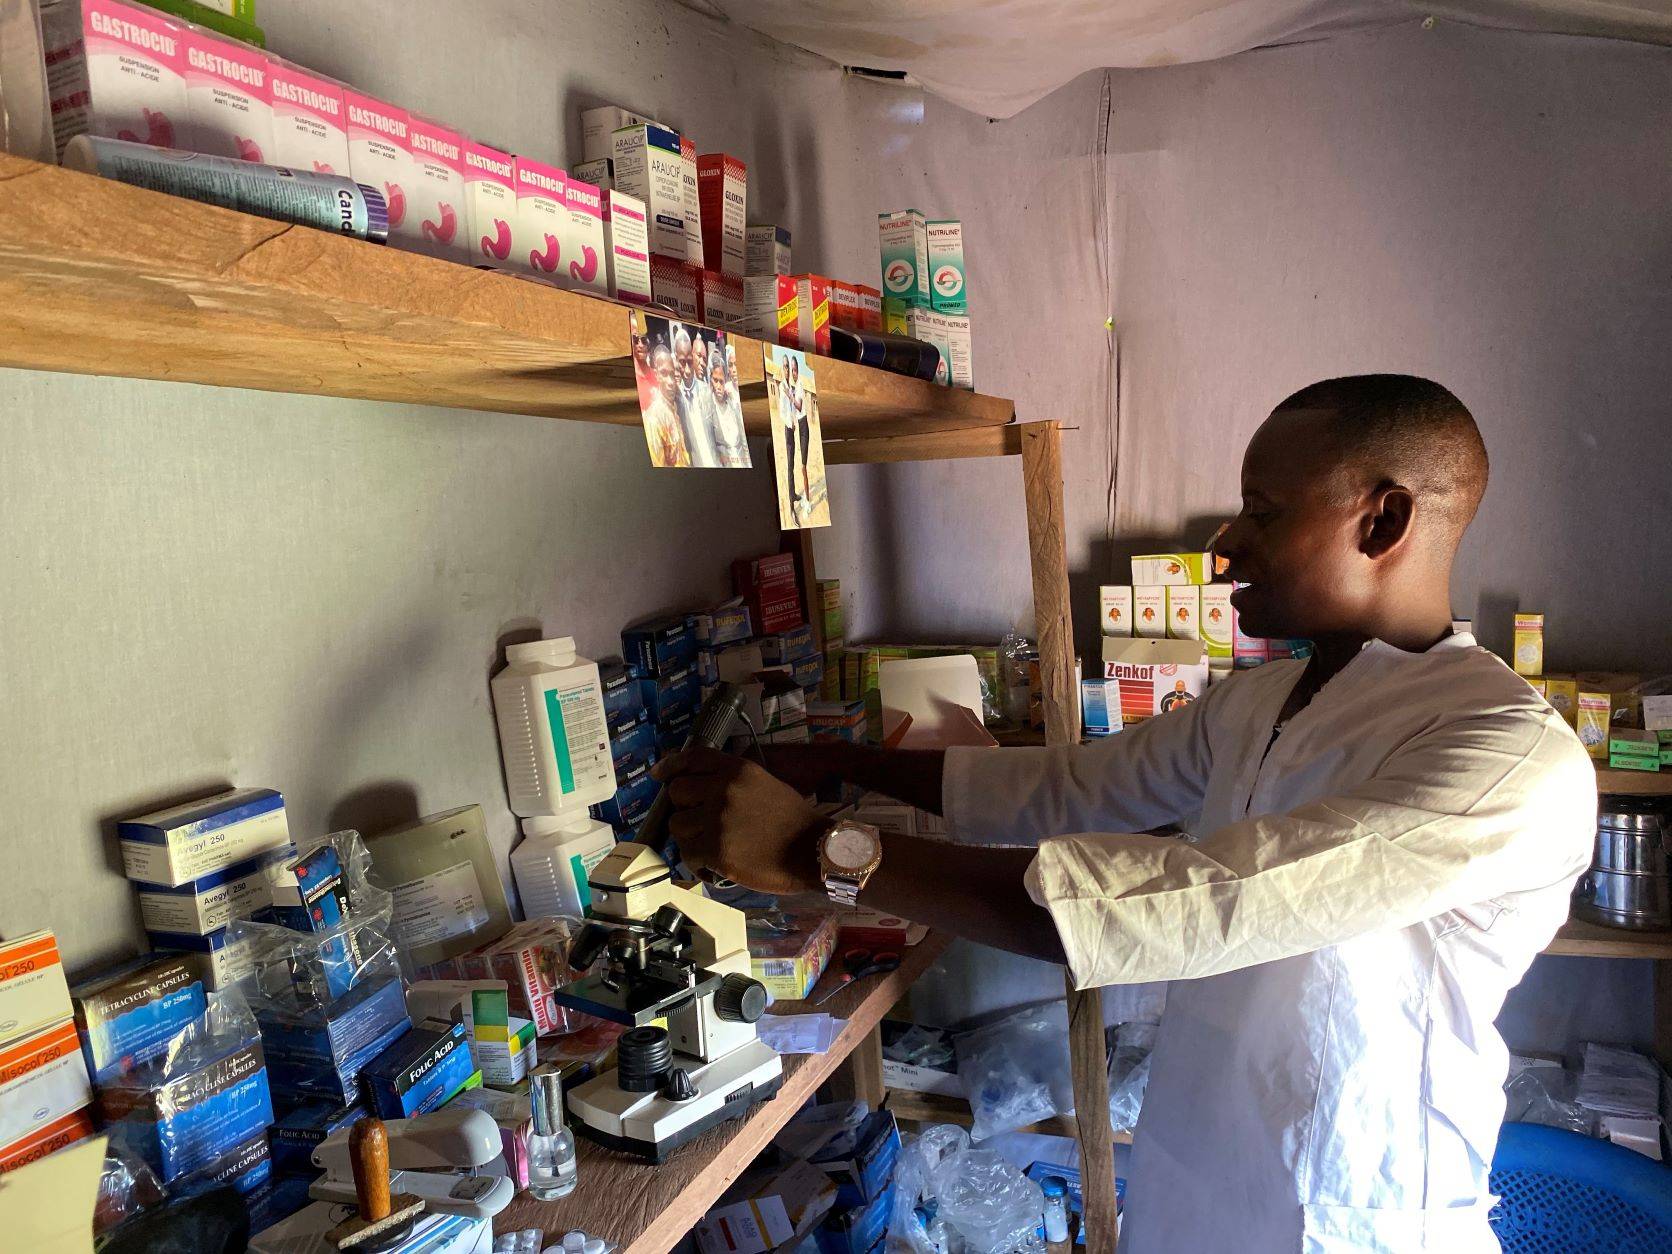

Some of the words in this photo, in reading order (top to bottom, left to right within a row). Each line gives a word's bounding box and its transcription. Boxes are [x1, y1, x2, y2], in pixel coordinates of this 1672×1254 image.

[91, 11, 176, 57] GASTROCID
[188, 47, 264, 87] GASTROCID
[272, 79, 339, 115] GASTROCID
[349, 105, 407, 138] GASTROCID
[466, 151, 512, 178] GASTROCID
[520, 169, 564, 194] GASTROCID
[683, 174, 696, 186] OXIN
[567, 188, 600, 208] STROCID
[880, 220, 911, 231] NUTRILINE
[680, 302, 696, 314] LOXIN
[1107, 662, 1154, 680] Zenkof
[210, 833, 225, 845] 250
[203, 890, 230, 906] Avegyl
[232, 882, 246, 893] 250
[13, 960, 35, 976] 250
[100, 988, 156, 1016] TETRACYCLINE
[156, 972, 190, 994] CAPSULES
[163, 1000, 172, 1010] BP
[42, 1046, 61, 1064] 250
[410, 1058, 434, 1083] FOLIC
[434, 1040, 454, 1063] ACID
[225, 1059, 256, 1082] CAPSULES
[900, 1067, 918, 1076] Mini
[47, 1134, 71, 1153] 250
[238, 1145, 269, 1170] CAPSULES
